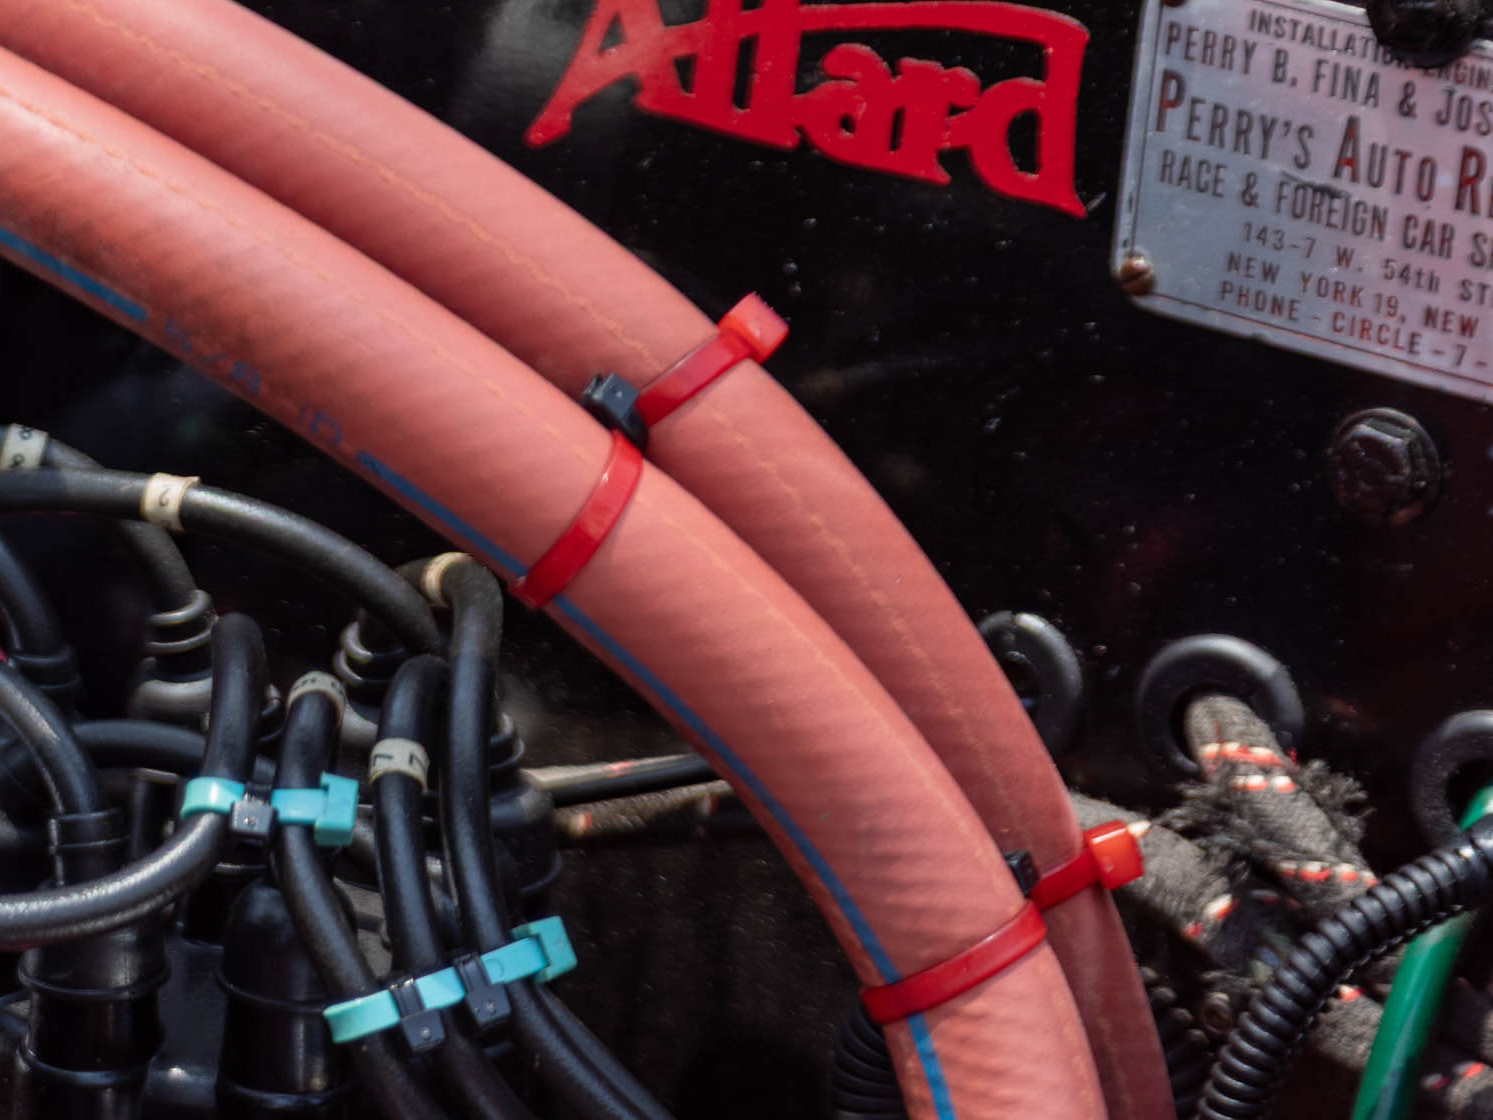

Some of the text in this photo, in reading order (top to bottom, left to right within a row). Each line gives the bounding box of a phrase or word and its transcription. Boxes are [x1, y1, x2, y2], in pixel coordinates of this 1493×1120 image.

[1166, 21, 1258, 76] PERRY
[1272, 48, 1298, 88] B.
[1313, 58, 1380, 109] FINA
[1398, 80, 1418, 118] &
[1249, 8, 1410, 70] INSTALLATIO
[1156, 68, 1493, 218] PERRY'S AUTO R
[1160, 149, 1493, 271] RACE & FOREIGN CAR S
[1227, 251, 1281, 285] NEW
[1301, 272, 1364, 308] YORK
[1423, 304, 1479, 339] NEW
[1243, 222, 1316, 258] 143-7
[1383, 258, 1440, 294] 54th
[1221, 279, 1300, 322] PHONE
[1332, 312, 1422, 355] CIRCLE
